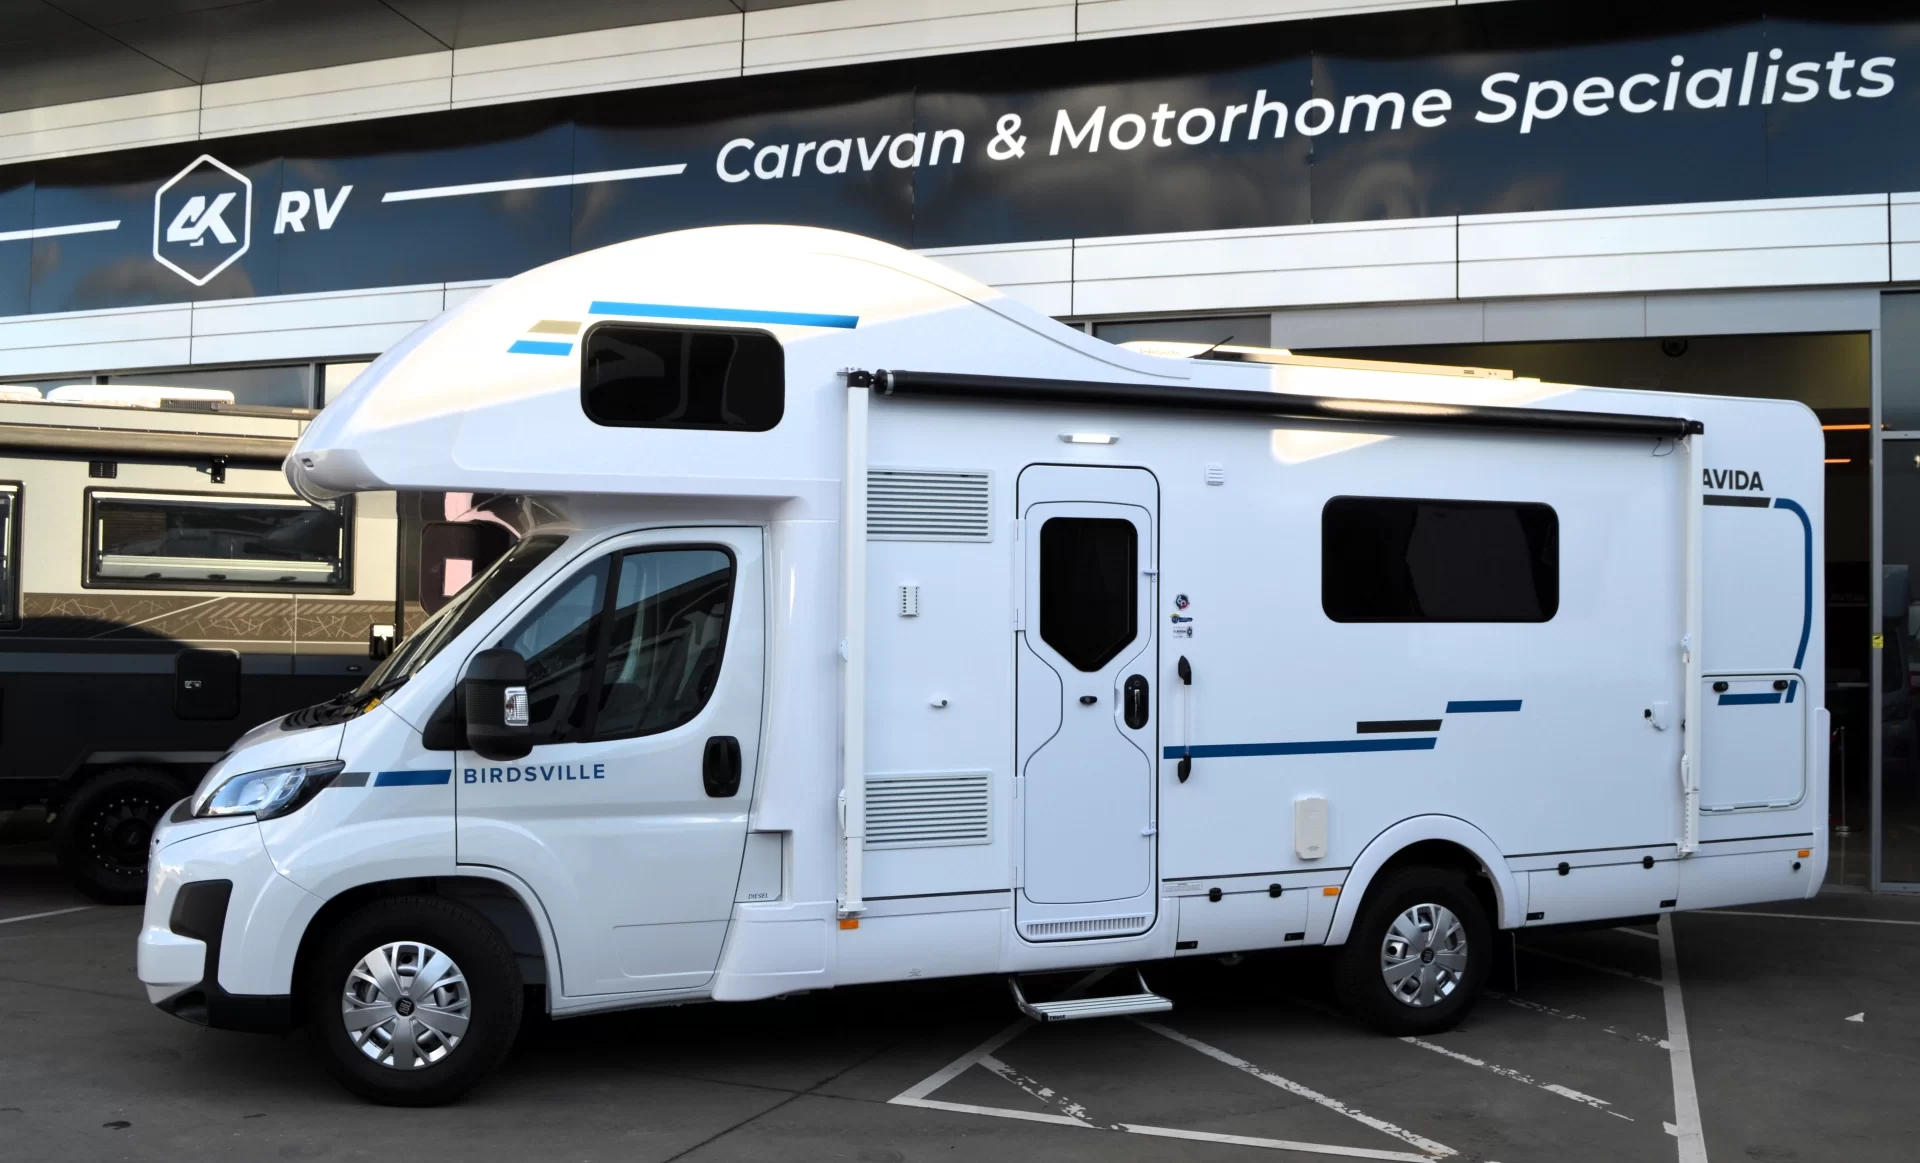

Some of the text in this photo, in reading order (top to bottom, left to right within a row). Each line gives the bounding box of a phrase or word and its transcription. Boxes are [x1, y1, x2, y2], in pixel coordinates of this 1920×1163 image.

[716, 49, 1896, 183] Caravan & Motorhome Specialists
[274, 185, 353, 234] RV
[1703, 468, 1764, 491] AVIDA
[463, 764, 605, 784] BIRDSVILLE
